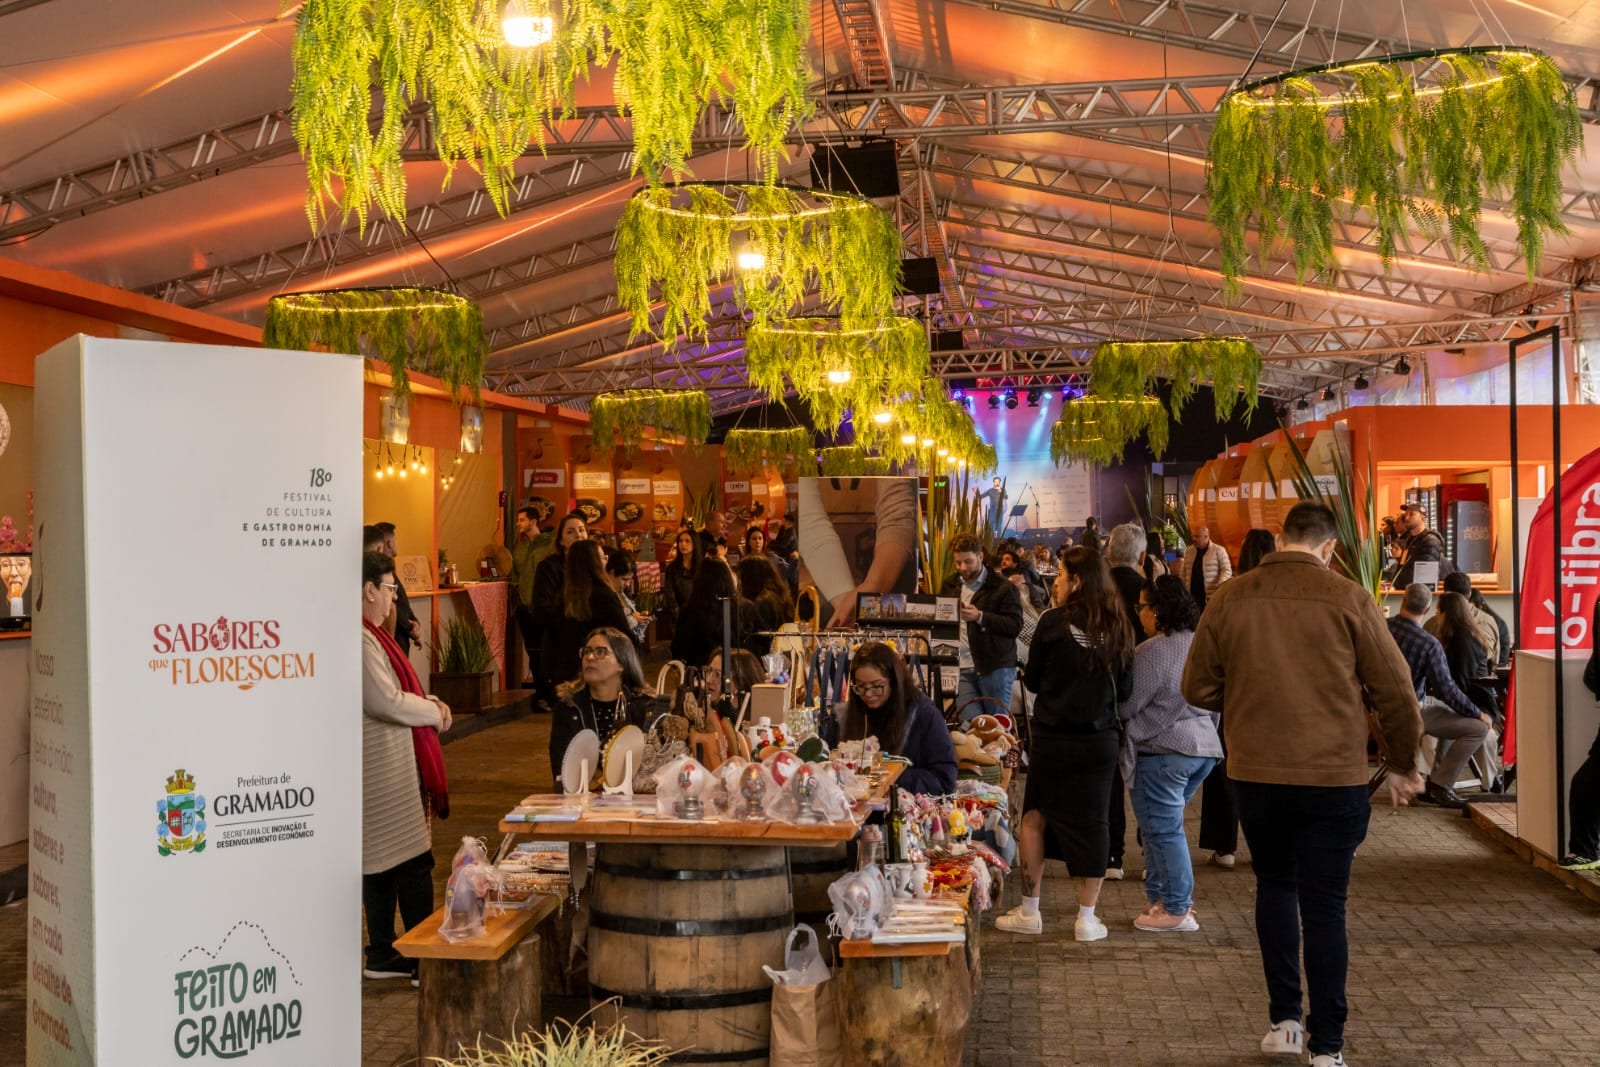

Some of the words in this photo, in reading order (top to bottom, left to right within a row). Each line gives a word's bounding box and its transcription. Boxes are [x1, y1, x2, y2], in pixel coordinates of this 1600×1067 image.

[283, 492, 332, 502] FESTIVAL
[266, 507, 280, 517] DE
[284, 507, 332, 517] CULTURA
[242, 522, 249, 532] E
[253, 522, 332, 532] GASTRONOMIA
[262, 538, 275, 547] DE
[280, 538, 332, 547] GRAMADO
[153, 616, 281, 654] SABORES
[149, 658, 169, 672] que
[172, 652, 315, 686] FLORESCEM
[237, 775, 279, 788] Prefeitura
[280, 772, 291, 784] de
[213, 786, 315, 817] GRAMADO
[216, 834, 277, 849] DESENVOLVIMENTO
[278, 829, 315, 842] ECONÔMICO
[222, 828, 261, 840] SECRETARIA
[261, 826, 271, 835] DE
[271, 821, 302, 833] INOVAÇÃO
[303, 821, 308, 830] E
[174, 999, 302, 1059] GRAMADO
